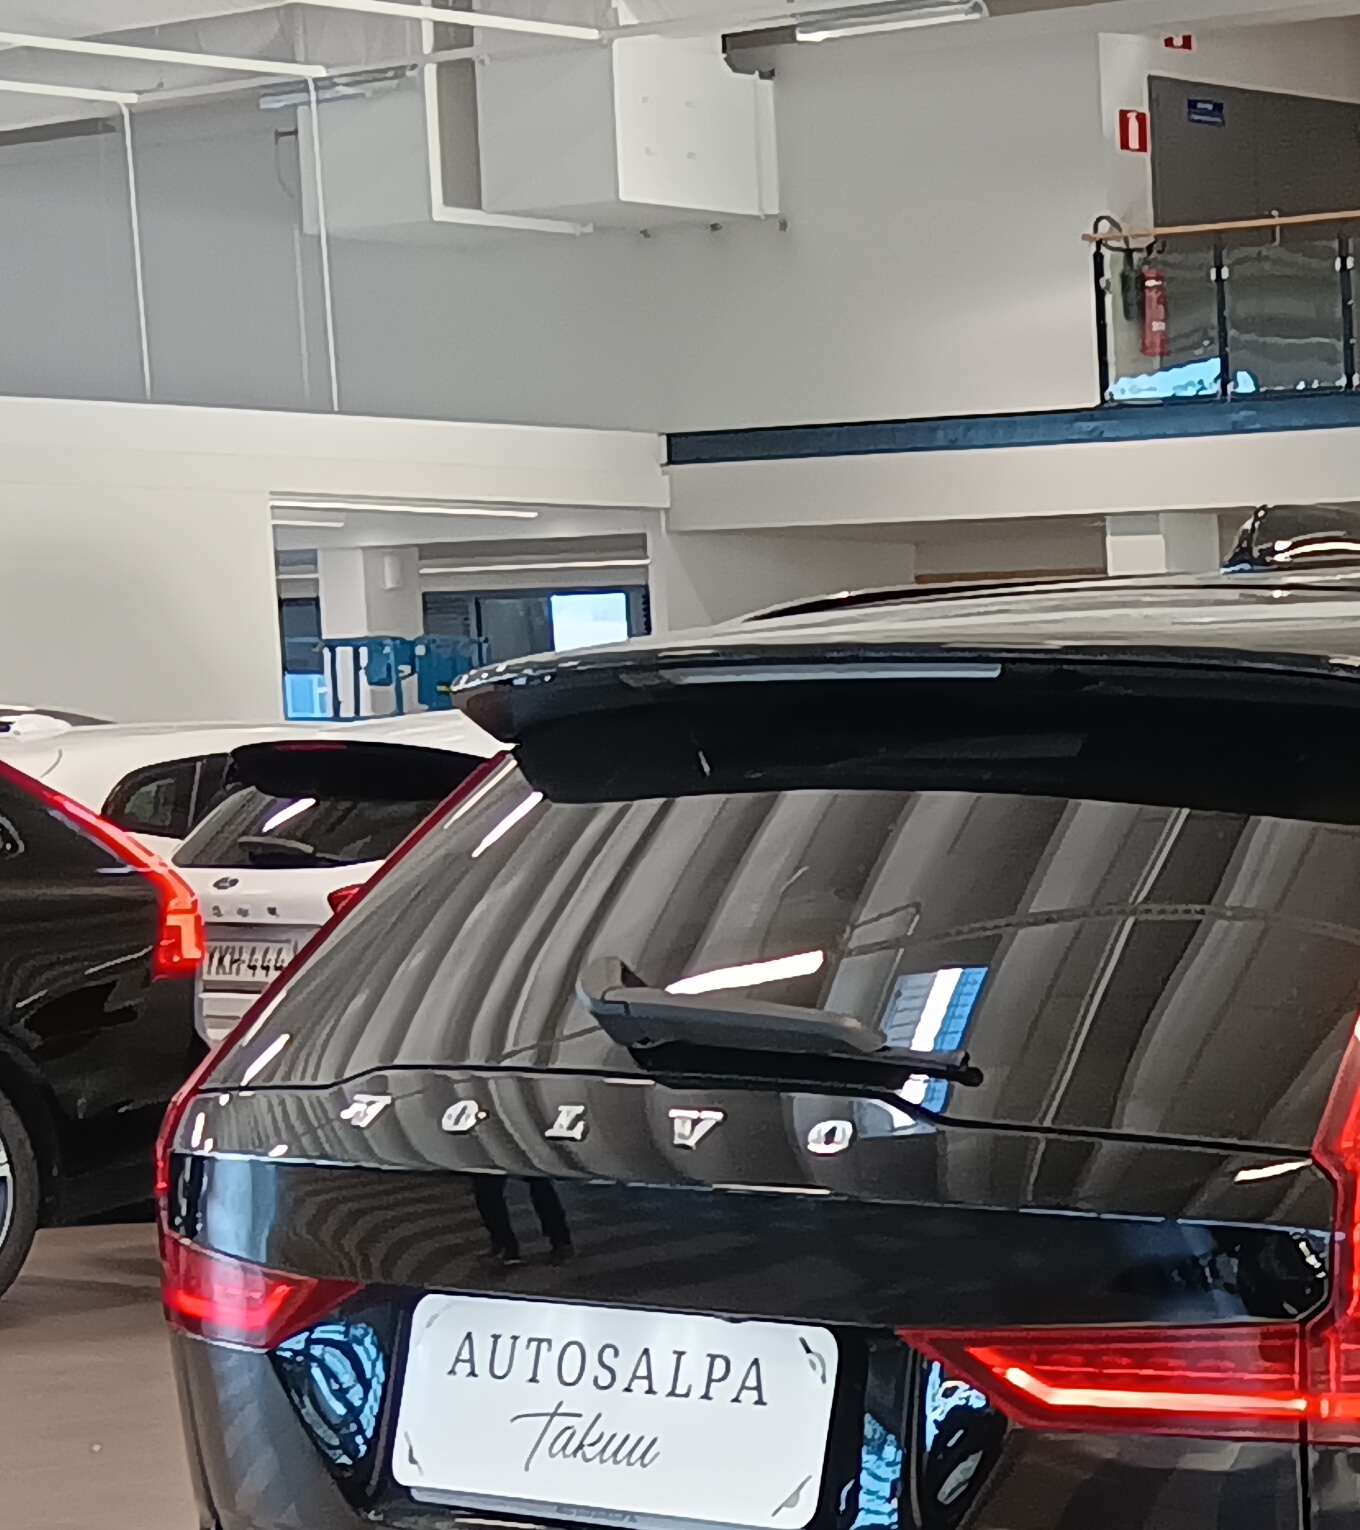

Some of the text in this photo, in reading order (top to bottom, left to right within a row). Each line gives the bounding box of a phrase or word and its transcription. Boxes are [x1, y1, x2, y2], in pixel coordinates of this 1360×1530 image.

[340, 1093, 855, 1156] VOLVO
[446, 1331, 768, 1406] AUTOSALPA
[509, 1400, 661, 1472] Takuu
